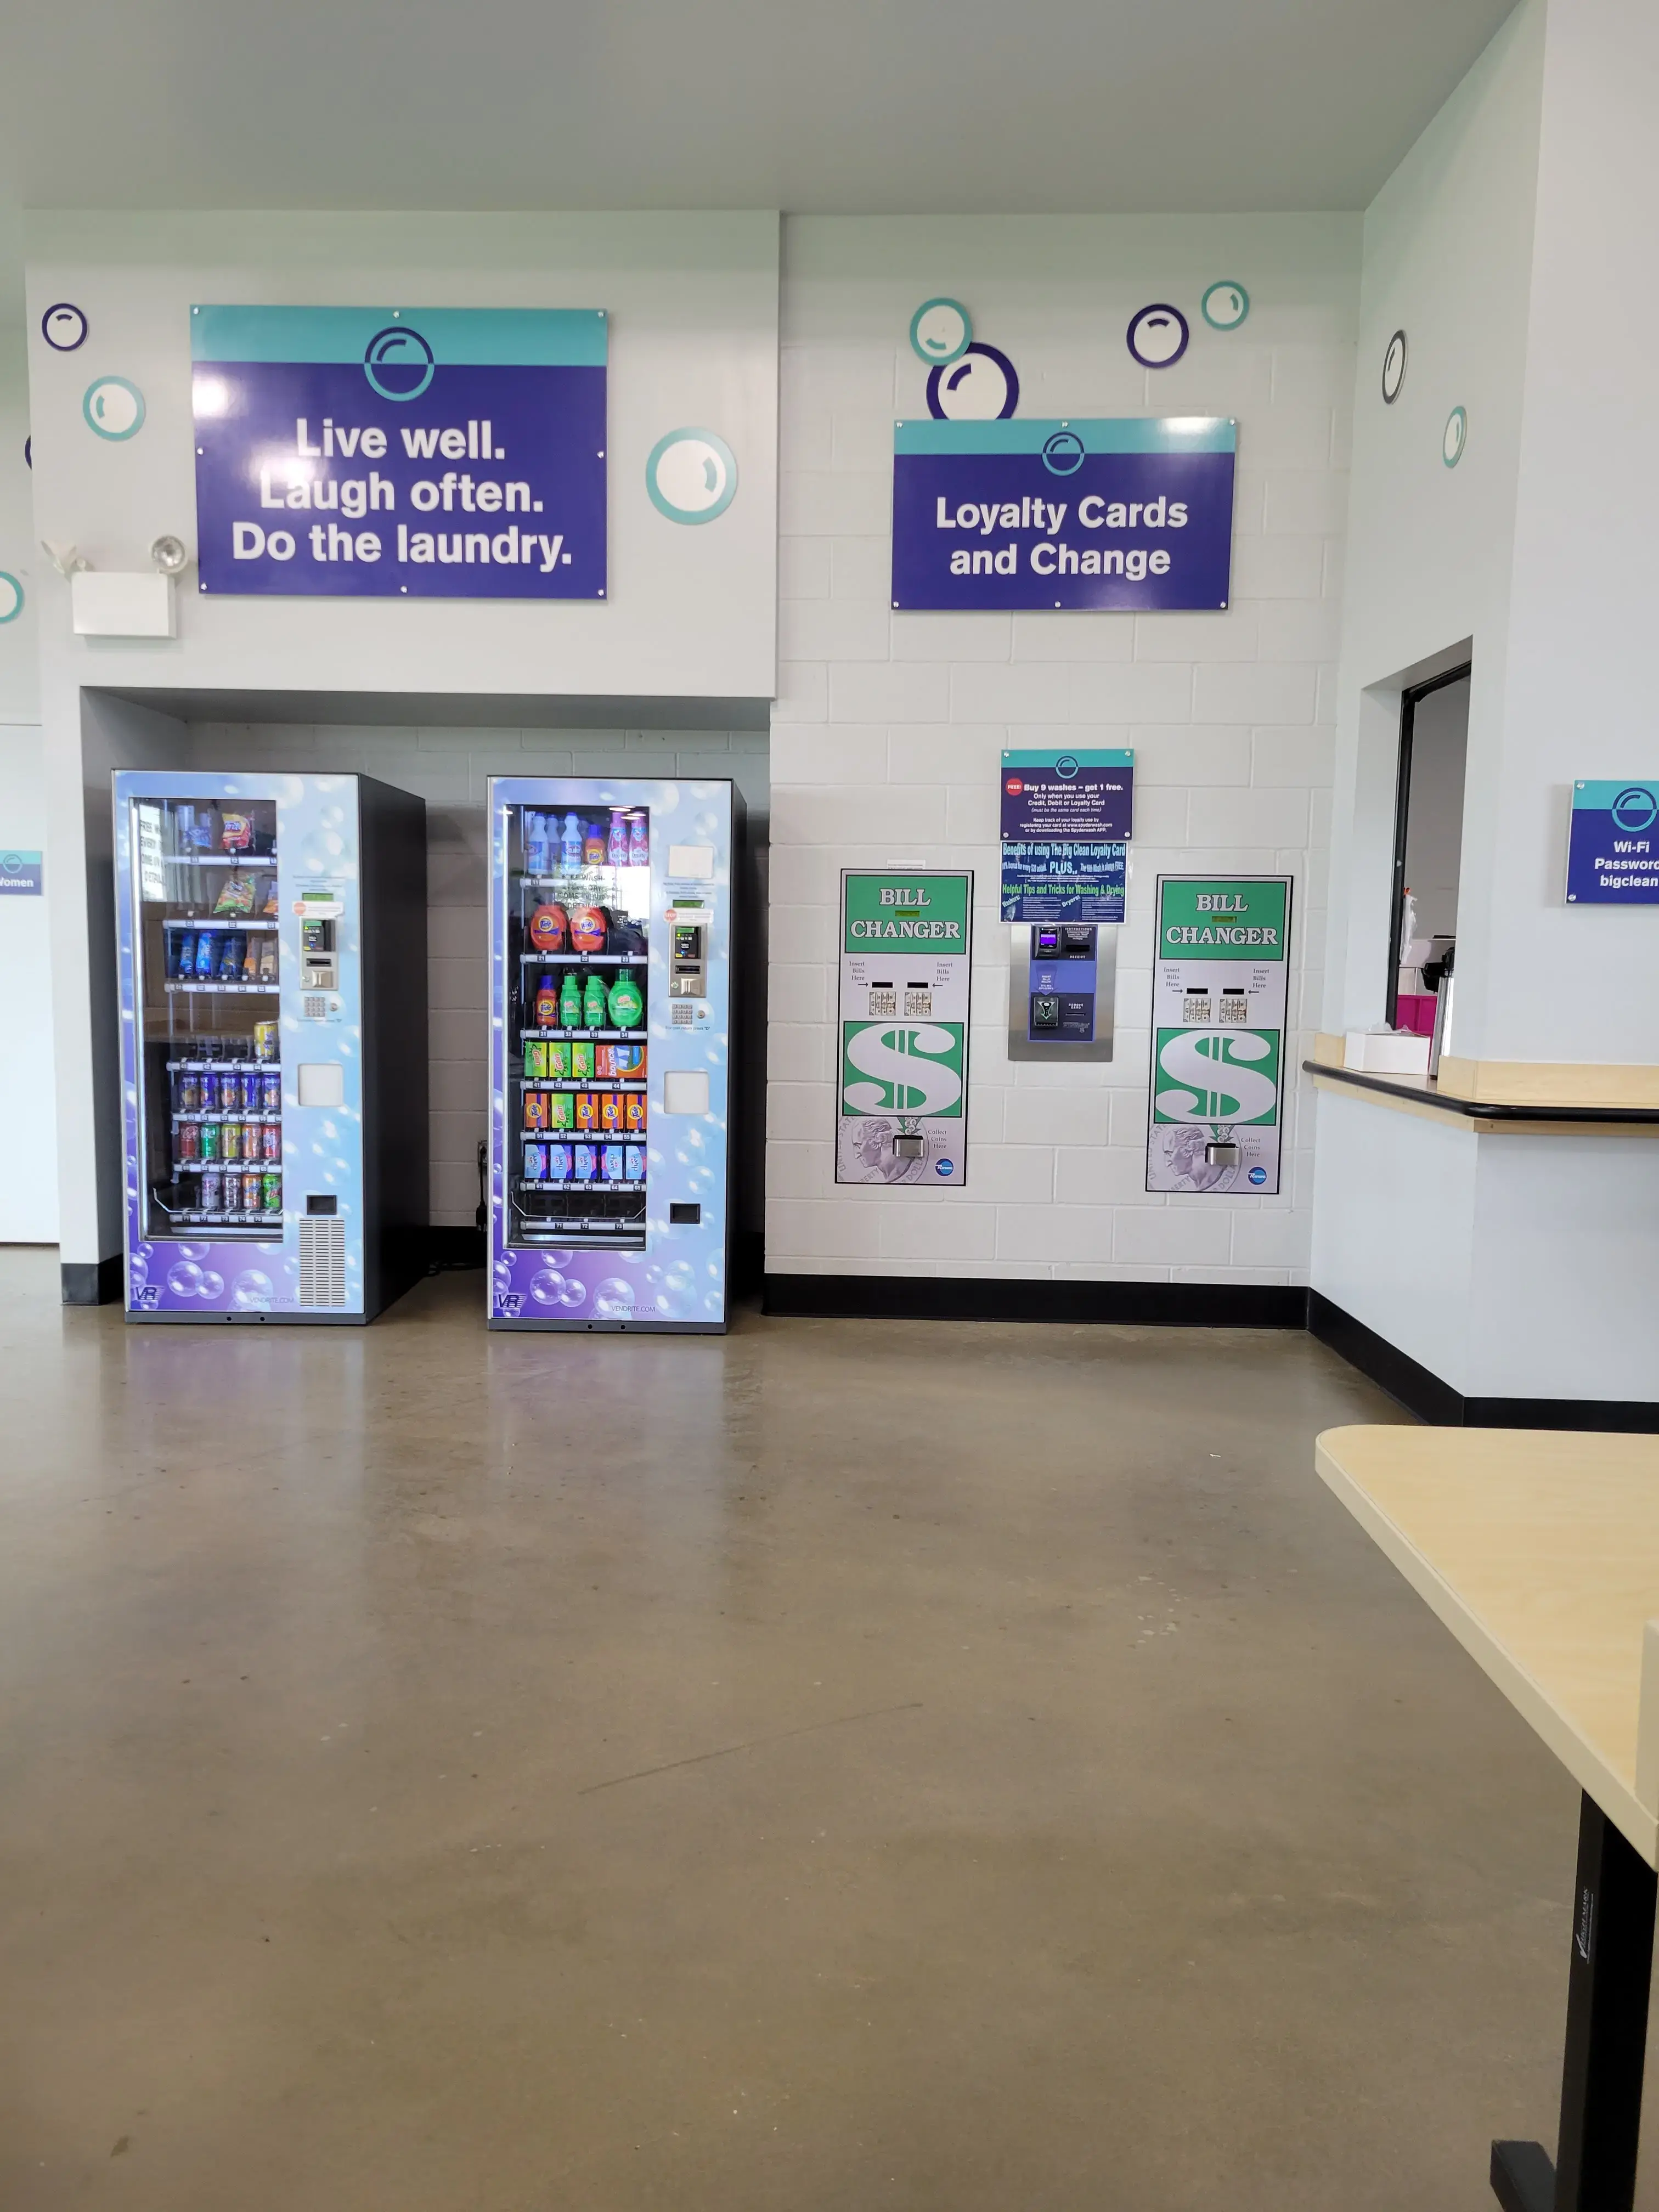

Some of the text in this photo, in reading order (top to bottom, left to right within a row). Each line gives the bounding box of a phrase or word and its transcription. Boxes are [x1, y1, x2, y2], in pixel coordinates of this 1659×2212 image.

[296, 418, 505, 459] Live well.
[260, 470, 543, 518] Laugh often.
[937, 495, 1188, 535] Loyalty Cards
[233, 522, 571, 572] Do the laundry.
[950, 543, 1170, 581] and Change
[1003, 843, 1125, 859] Benefits of using The Big Clean Loyalty Card
[1614, 840, 1650, 853] Wi-Fi
[1600, 874, 1658, 888] bigclean
[879, 888, 931, 906] BILL
[1002, 884, 1022, 896] Helpful
[1023, 884, 1035, 896] Tips
[1036, 884, 1047, 894] and
[1048, 884, 1065, 894] Tricks
[1075, 884, 1098, 896] Washing
[1101, 884, 1105, 894] &
[1107, 884, 1124, 896] Drying
[1195, 894, 1249, 912] BILL
[540, 919, 551, 928] Tide
[581, 921, 592, 929] Tide
[851, 920, 961, 939] CHANGER
[1166, 927, 1278, 945] CHANGER
[555, 1054, 563, 1069] Gain
[578, 1054, 587, 1070] Gain
[608, 1048, 617, 1076] bounce
[557, 1105, 566, 1121] Gain
[582, 1105, 590, 1117] Tide
[607, 1105, 616, 1118] Tide
[632, 1106, 640, 1118] Tide
